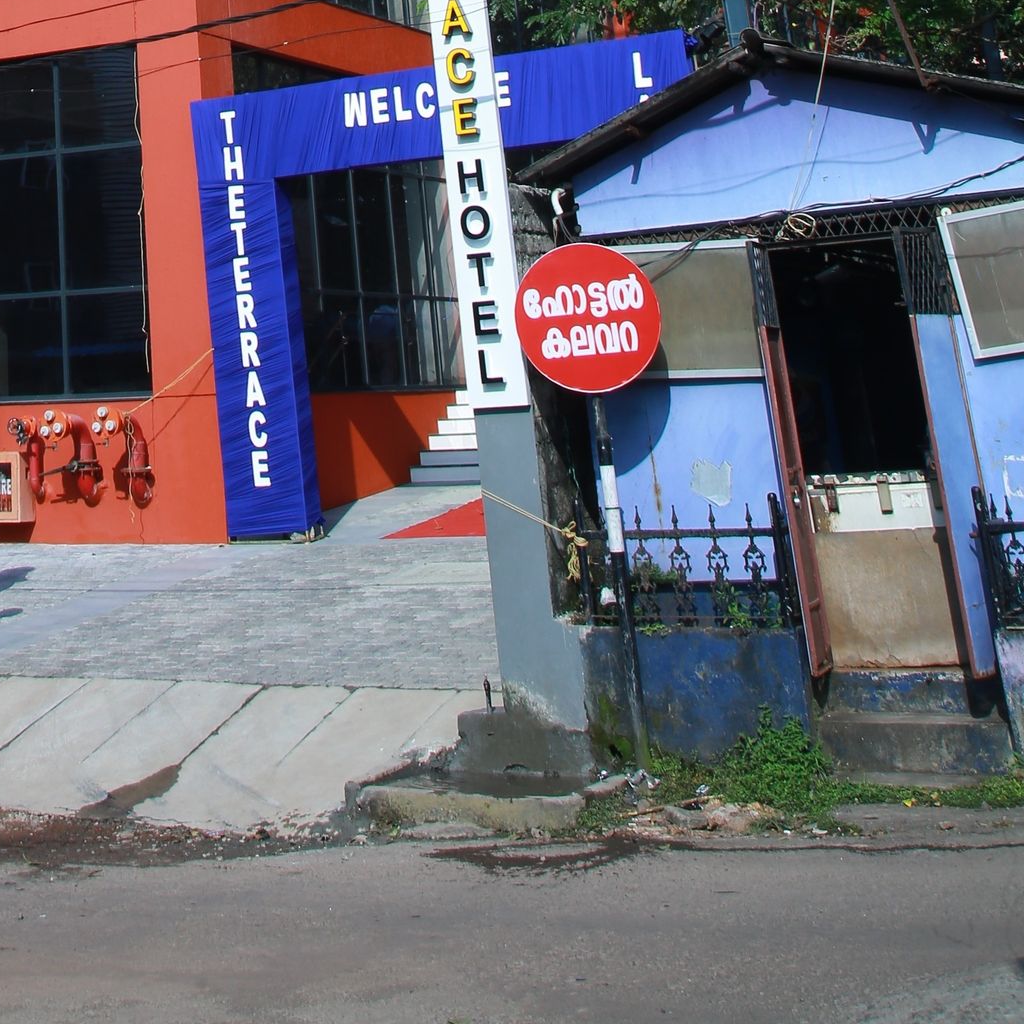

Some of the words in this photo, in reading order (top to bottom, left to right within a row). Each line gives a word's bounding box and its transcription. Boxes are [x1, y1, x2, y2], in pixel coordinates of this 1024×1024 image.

[343, 71, 512, 128] WELCE
[457, 159, 503, 385] HOTEL
[522, 273, 644, 320] ഹോട്ടൽ
[541, 320, 639, 359] കലവറ
